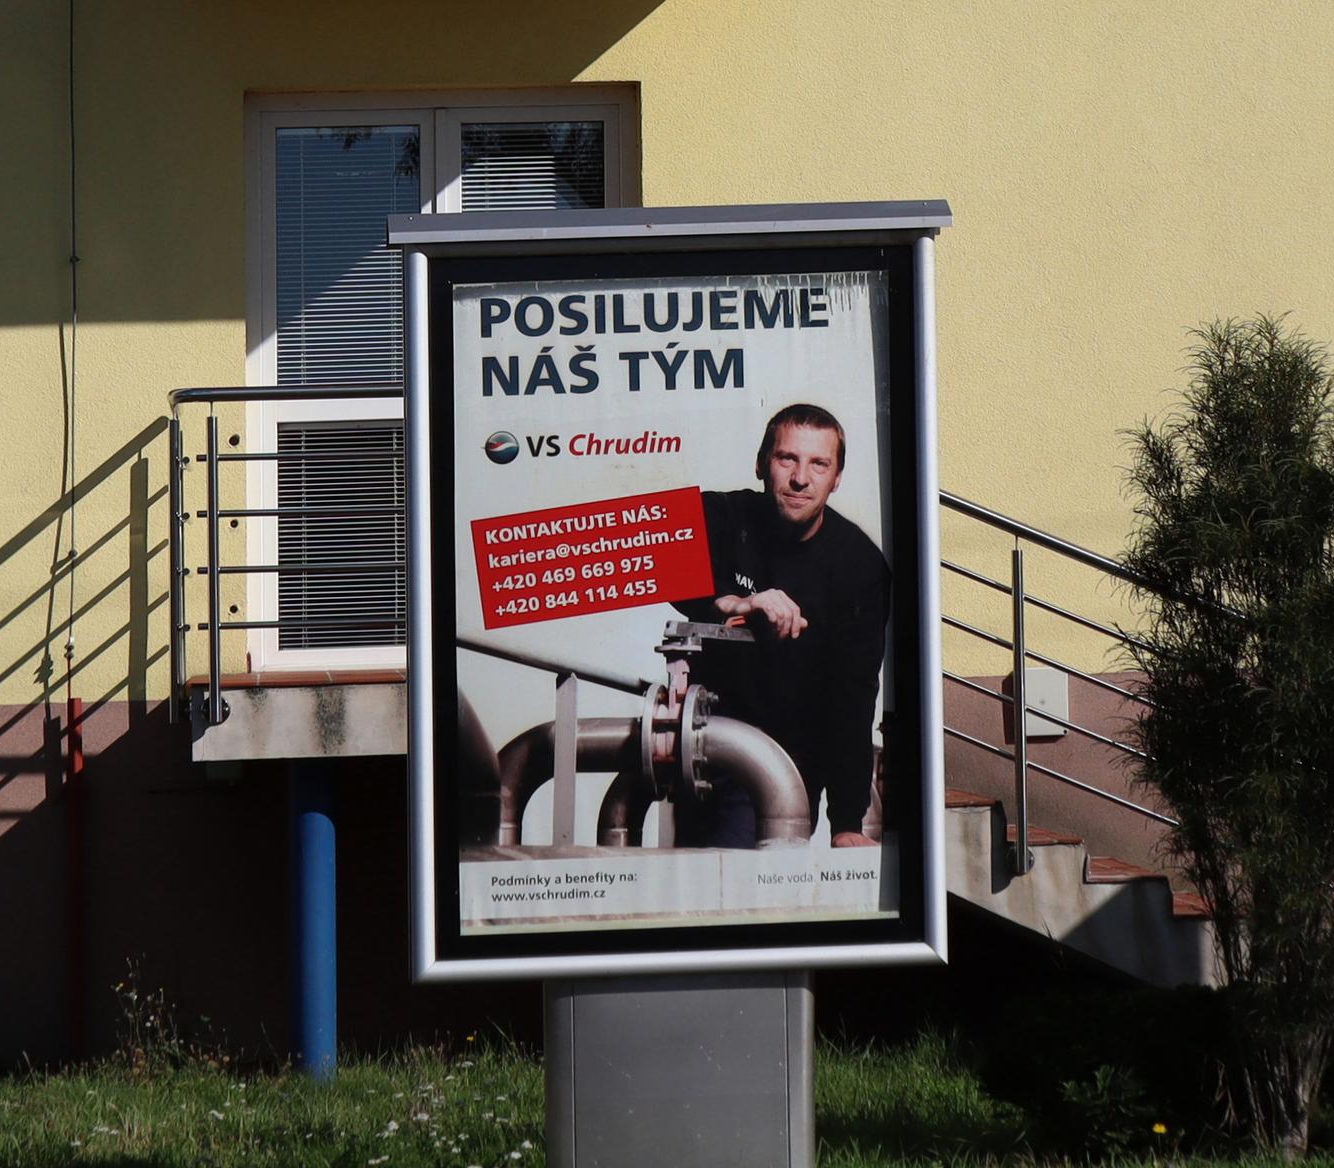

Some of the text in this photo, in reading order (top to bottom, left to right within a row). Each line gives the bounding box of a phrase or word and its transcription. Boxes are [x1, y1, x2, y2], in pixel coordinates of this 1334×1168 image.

[480, 288, 829, 337] POSILUJEME
[482, 342, 745, 396] NÁŠ TÝM
[526, 432, 681, 457] VS Chrudim
[485, 505, 668, 545] KONTAKTUJTE NÁS:
[488, 528, 694, 568] kariera@vschrudim.cz
[492, 555, 654, 592] +420 469 669 975
[495, 579, 657, 616] +420 844 114 455
[491, 872, 637, 887] Podmínky a benefity na:
[491, 888, 606, 902] www.vschrudim.cz
[757, 873, 784, 885] Naše
[820, 870, 842, 882] Náš
[845, 869, 878, 881] život.
